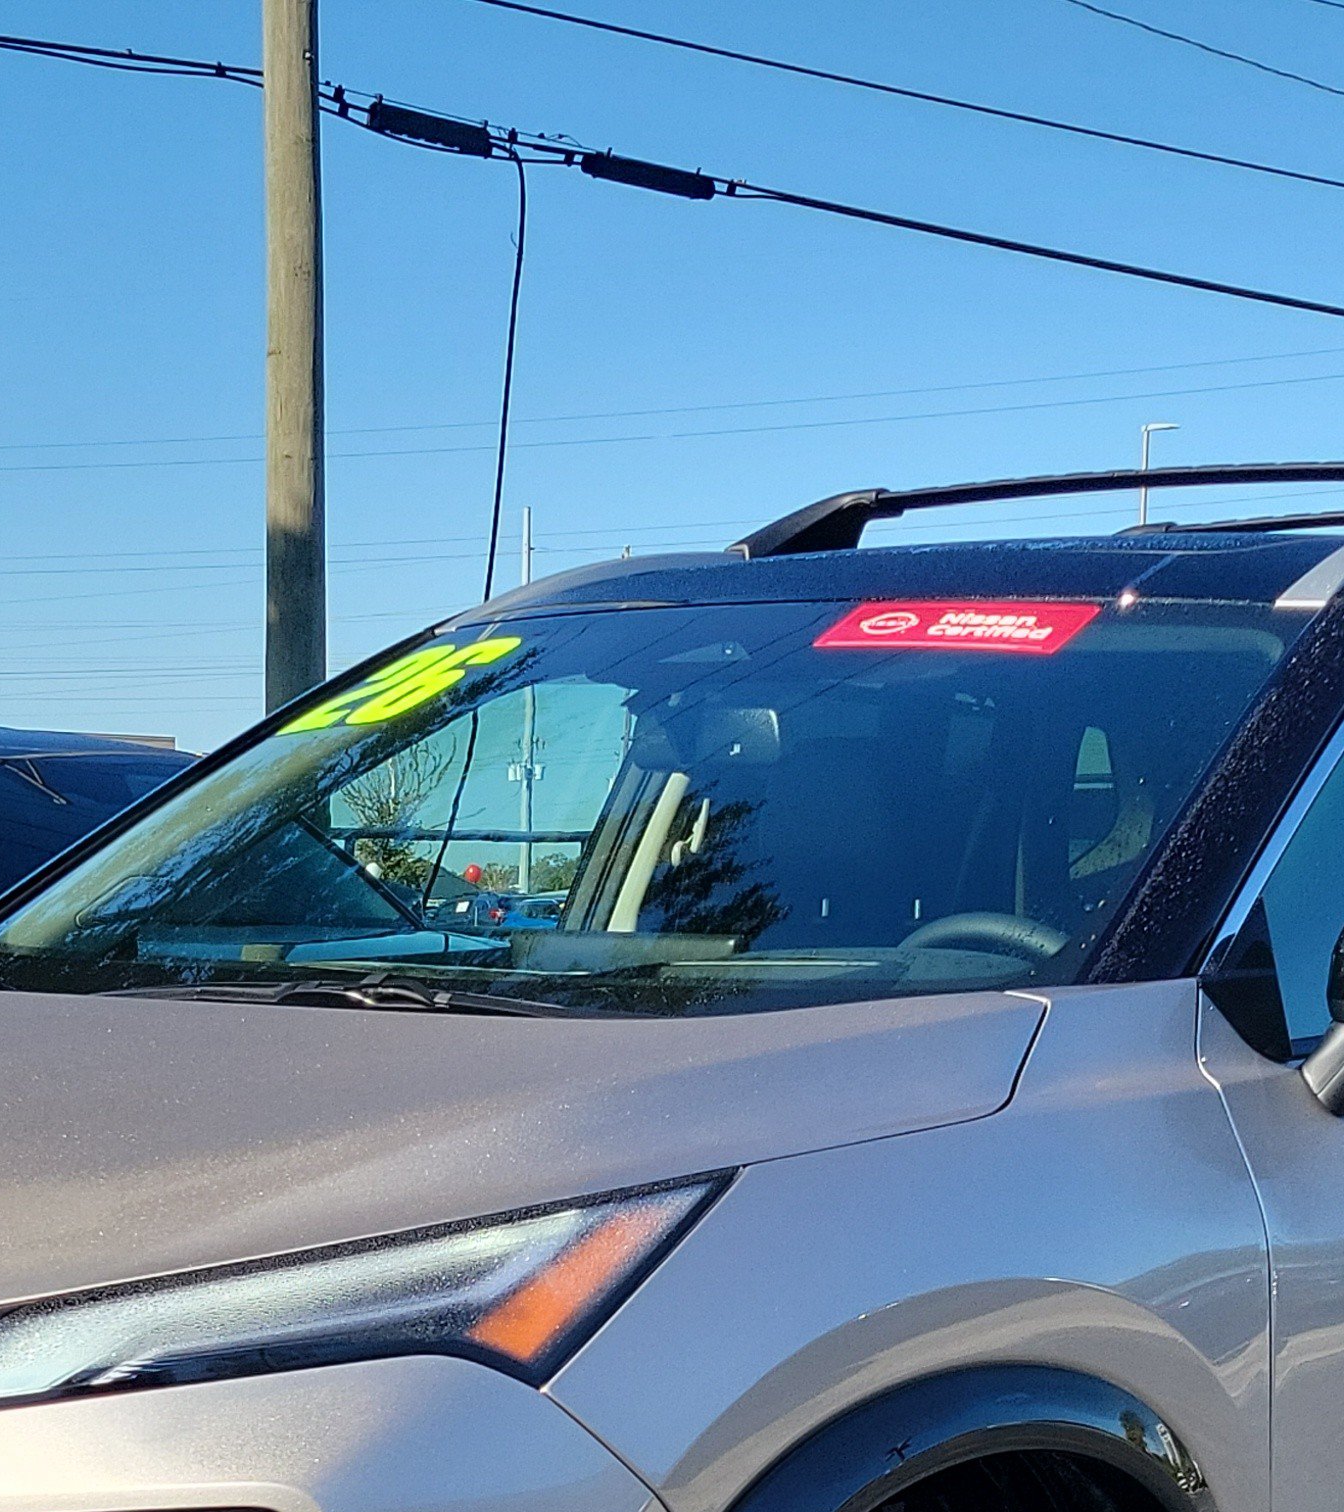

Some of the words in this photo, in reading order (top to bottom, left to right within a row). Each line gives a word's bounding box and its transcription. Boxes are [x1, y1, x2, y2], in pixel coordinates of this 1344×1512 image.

[939, 612, 1037, 627] Nissan
[927, 624, 1053, 639] Certified
[274, 636, 523, 736] 26
